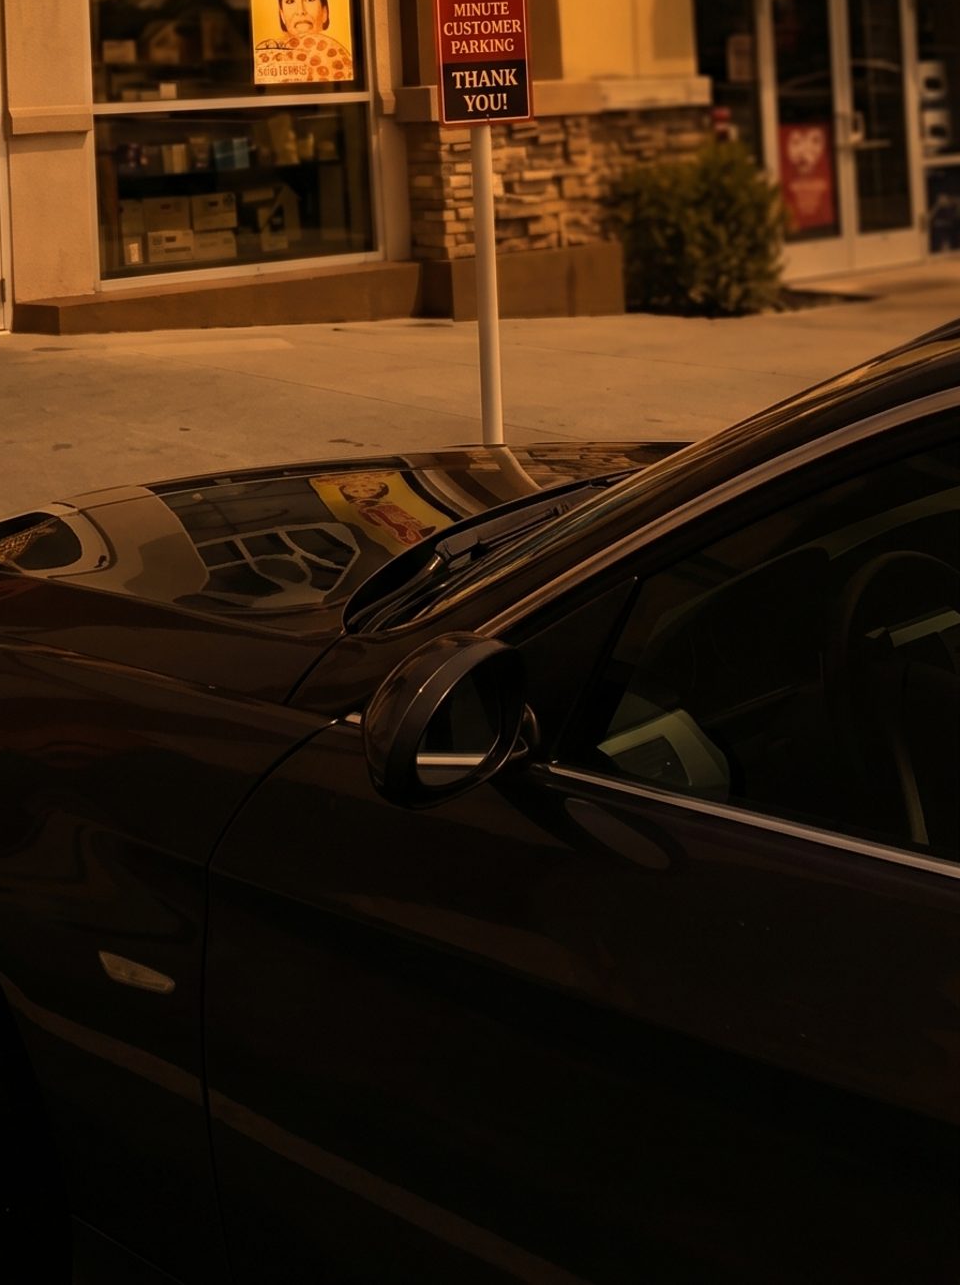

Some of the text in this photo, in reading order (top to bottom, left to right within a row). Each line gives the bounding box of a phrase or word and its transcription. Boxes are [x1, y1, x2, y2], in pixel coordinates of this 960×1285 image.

[454, 1, 509, 17] MINUTE
[443, 19, 522, 36] CUSTOMER
[451, 38, 514, 54] PARKING
[452, 68, 518, 89] THANK
[464, 93, 508, 112] YOU!
